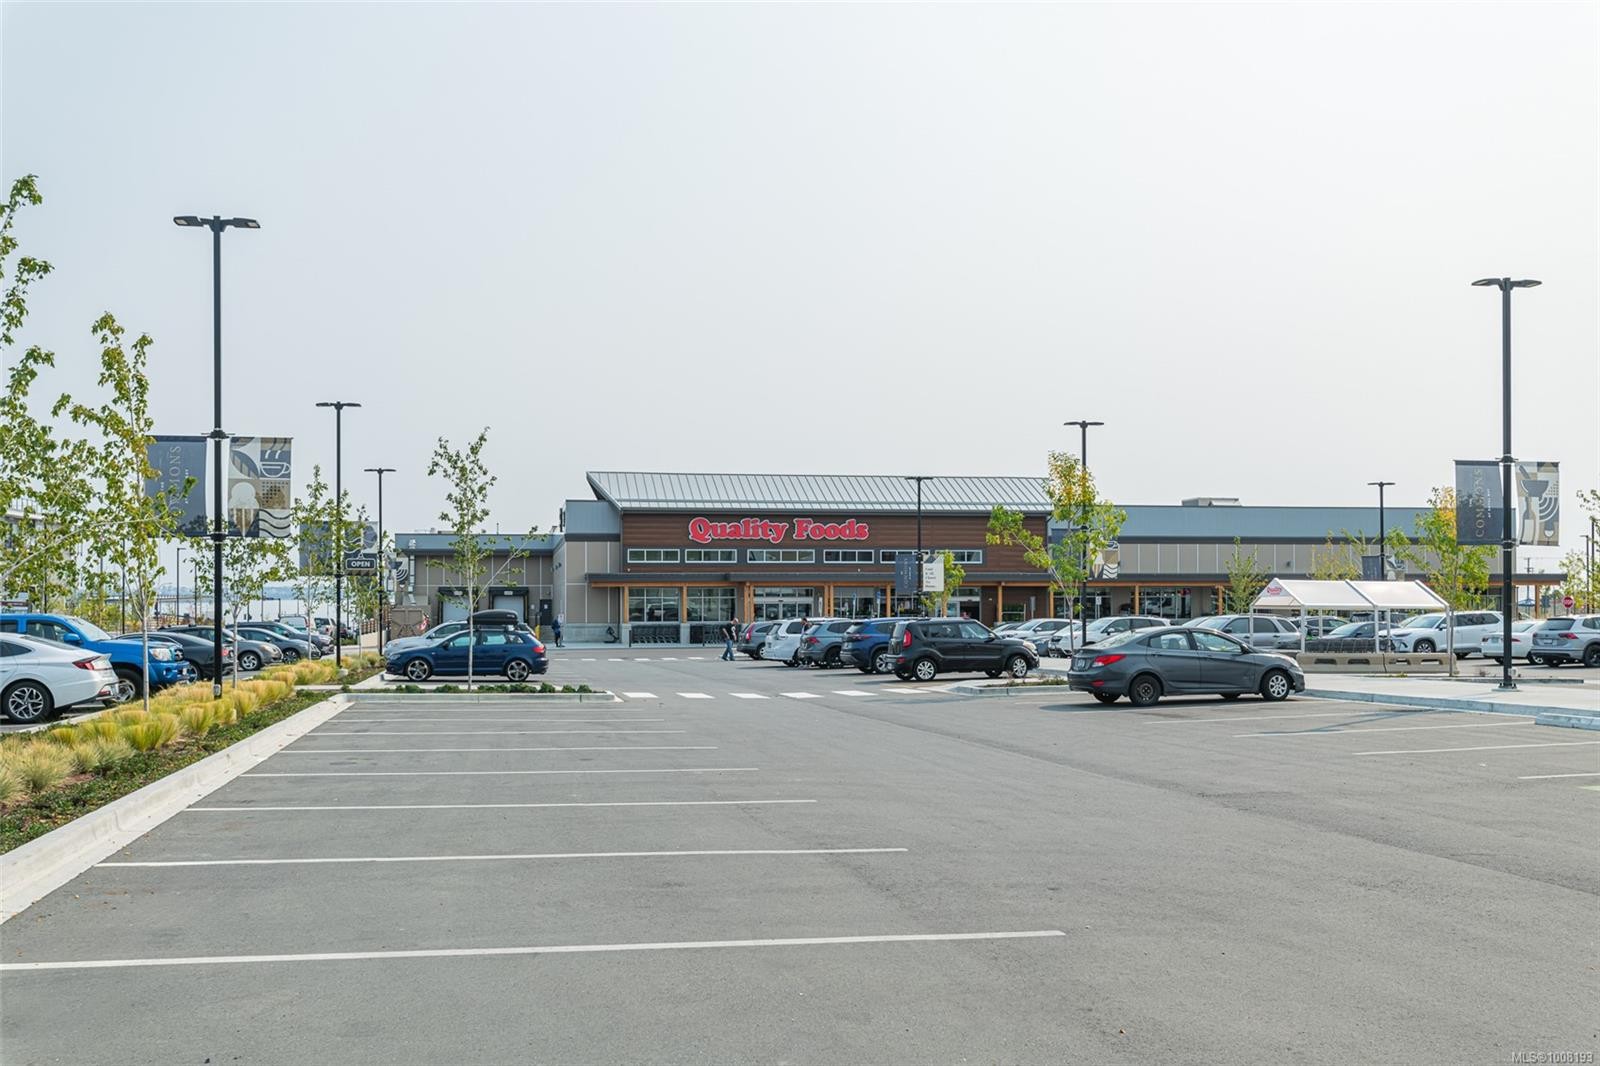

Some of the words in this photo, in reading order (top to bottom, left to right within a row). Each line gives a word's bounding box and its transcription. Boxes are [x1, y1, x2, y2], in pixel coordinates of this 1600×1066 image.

[1473, 468, 1485, 538] COMMONS
[689, 516, 789, 543] Quality
[793, 518, 869, 540] Foods
[351, 560, 371, 568] OPEN
